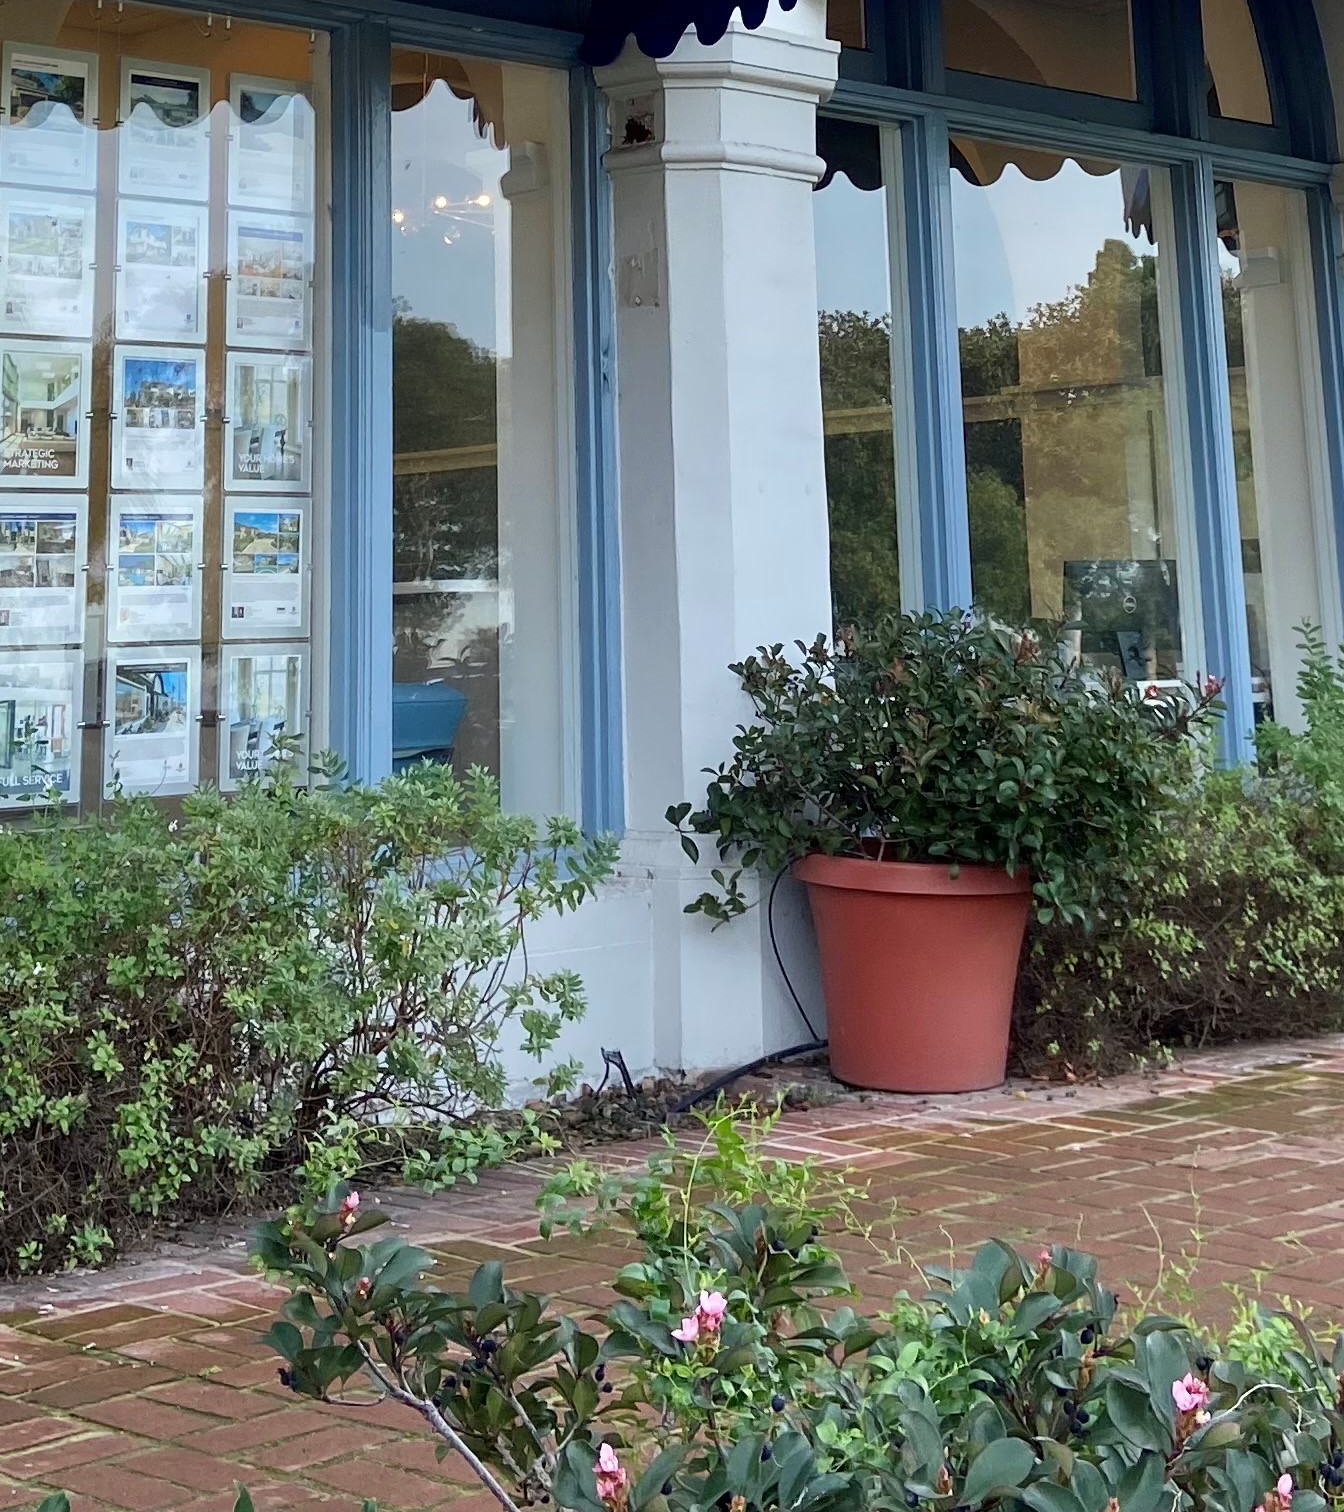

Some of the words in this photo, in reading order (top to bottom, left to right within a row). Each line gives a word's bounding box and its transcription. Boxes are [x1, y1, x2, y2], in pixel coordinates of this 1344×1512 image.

[238, 453, 262, 463] YOUR
[2, 459, 59, 470] MARKETING
[235, 749, 260, 760] YOUR
